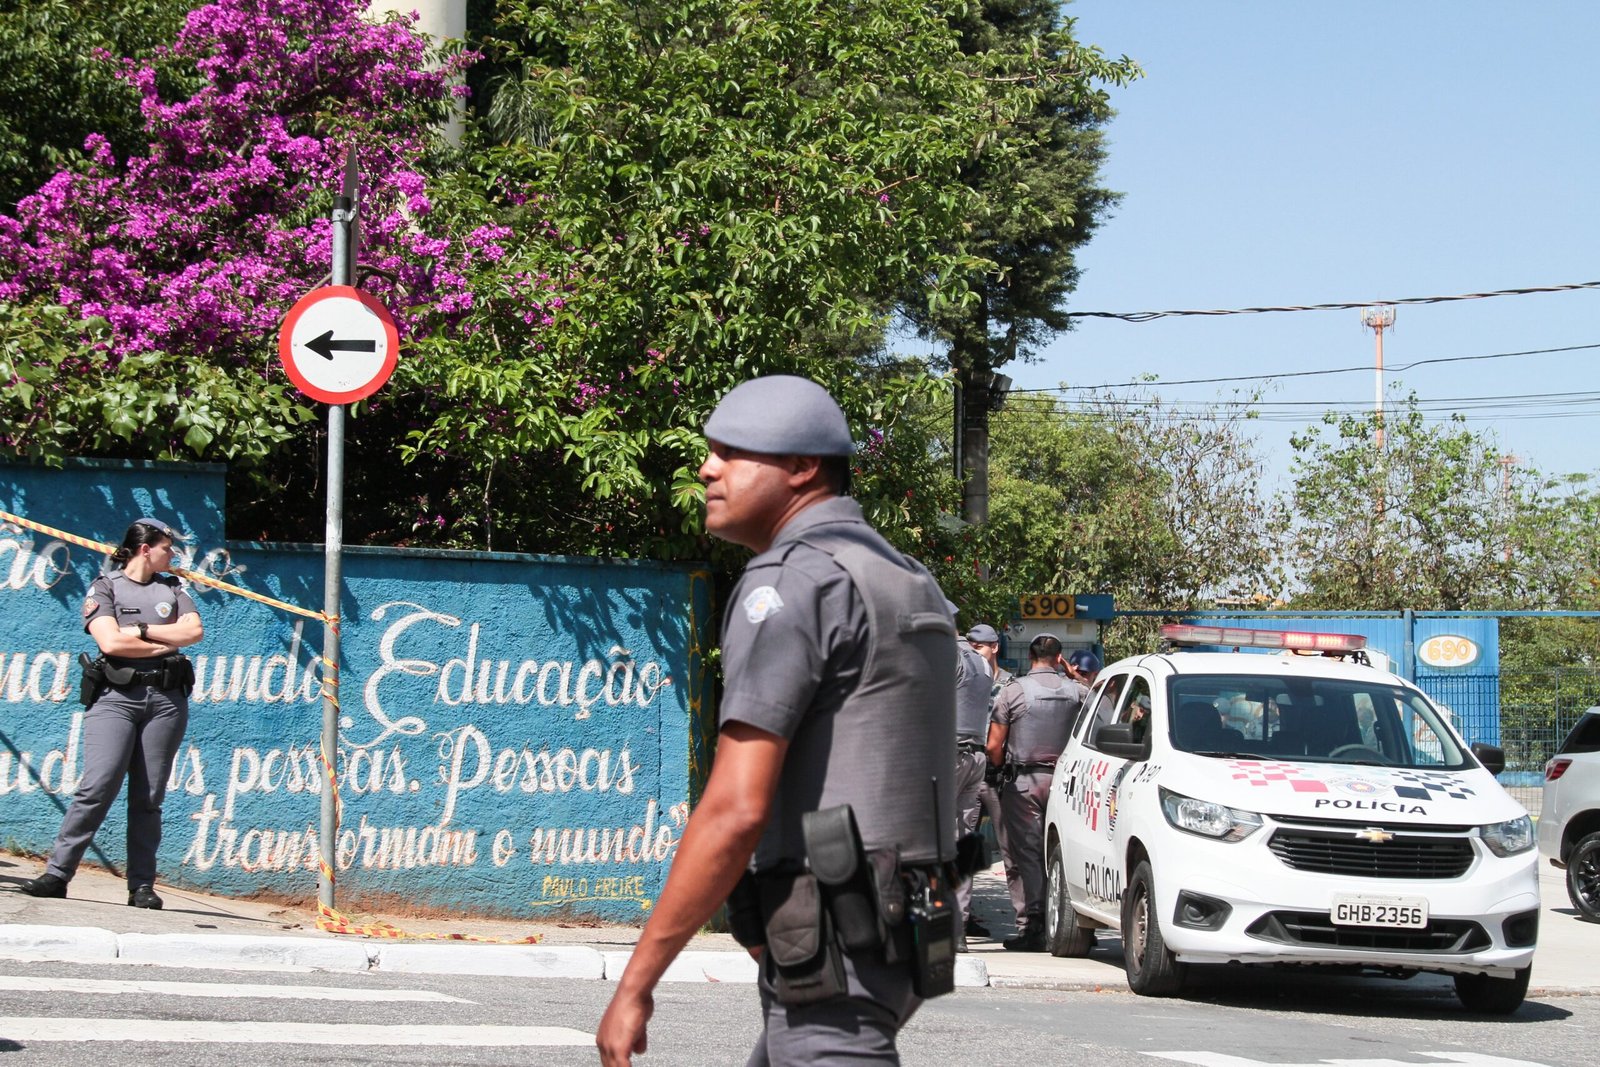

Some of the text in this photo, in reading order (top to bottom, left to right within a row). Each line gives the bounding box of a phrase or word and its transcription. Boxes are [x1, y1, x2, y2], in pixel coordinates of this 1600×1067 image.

[1024, 597, 1069, 616] 690
[340, 601, 672, 747] Educação
[1428, 639, 1471, 661] 690
[432, 723, 641, 828] Pessoas
[182, 793, 479, 873] transormam
[492, 828, 516, 868] o
[542, 875, 645, 898] PAULO FREIRE
[1085, 855, 1122, 903] POLÍCIA
